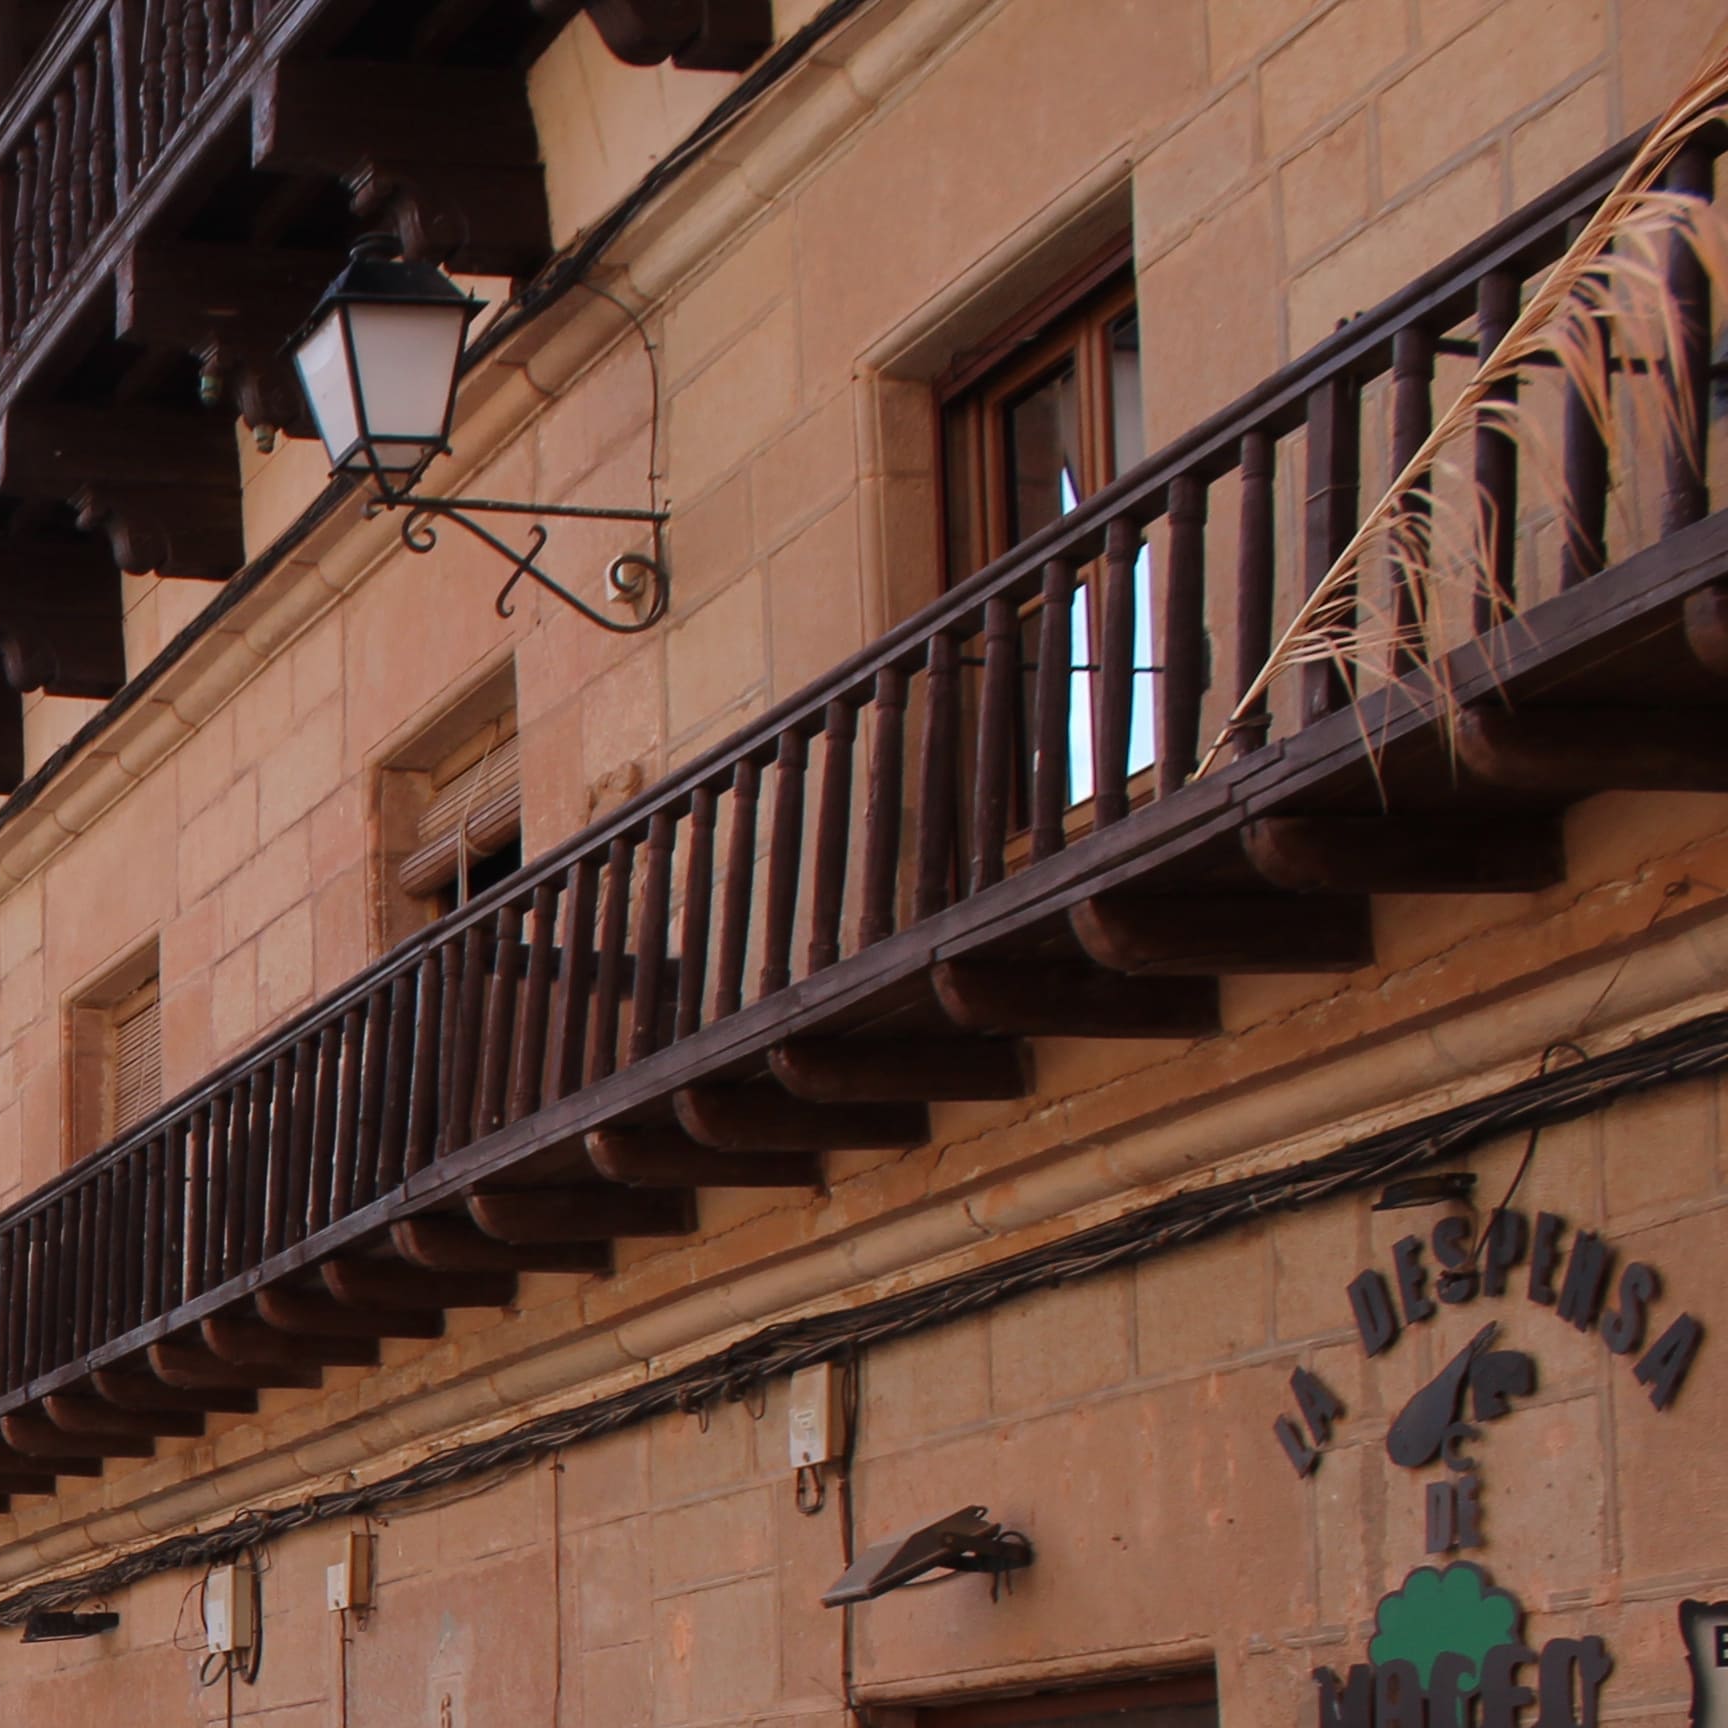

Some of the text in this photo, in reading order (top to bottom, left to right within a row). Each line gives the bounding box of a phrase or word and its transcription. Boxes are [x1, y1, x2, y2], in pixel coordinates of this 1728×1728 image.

[1273, 1207, 1705, 1479] LA DESPENSA
[1426, 1474, 1482, 1554] DE
